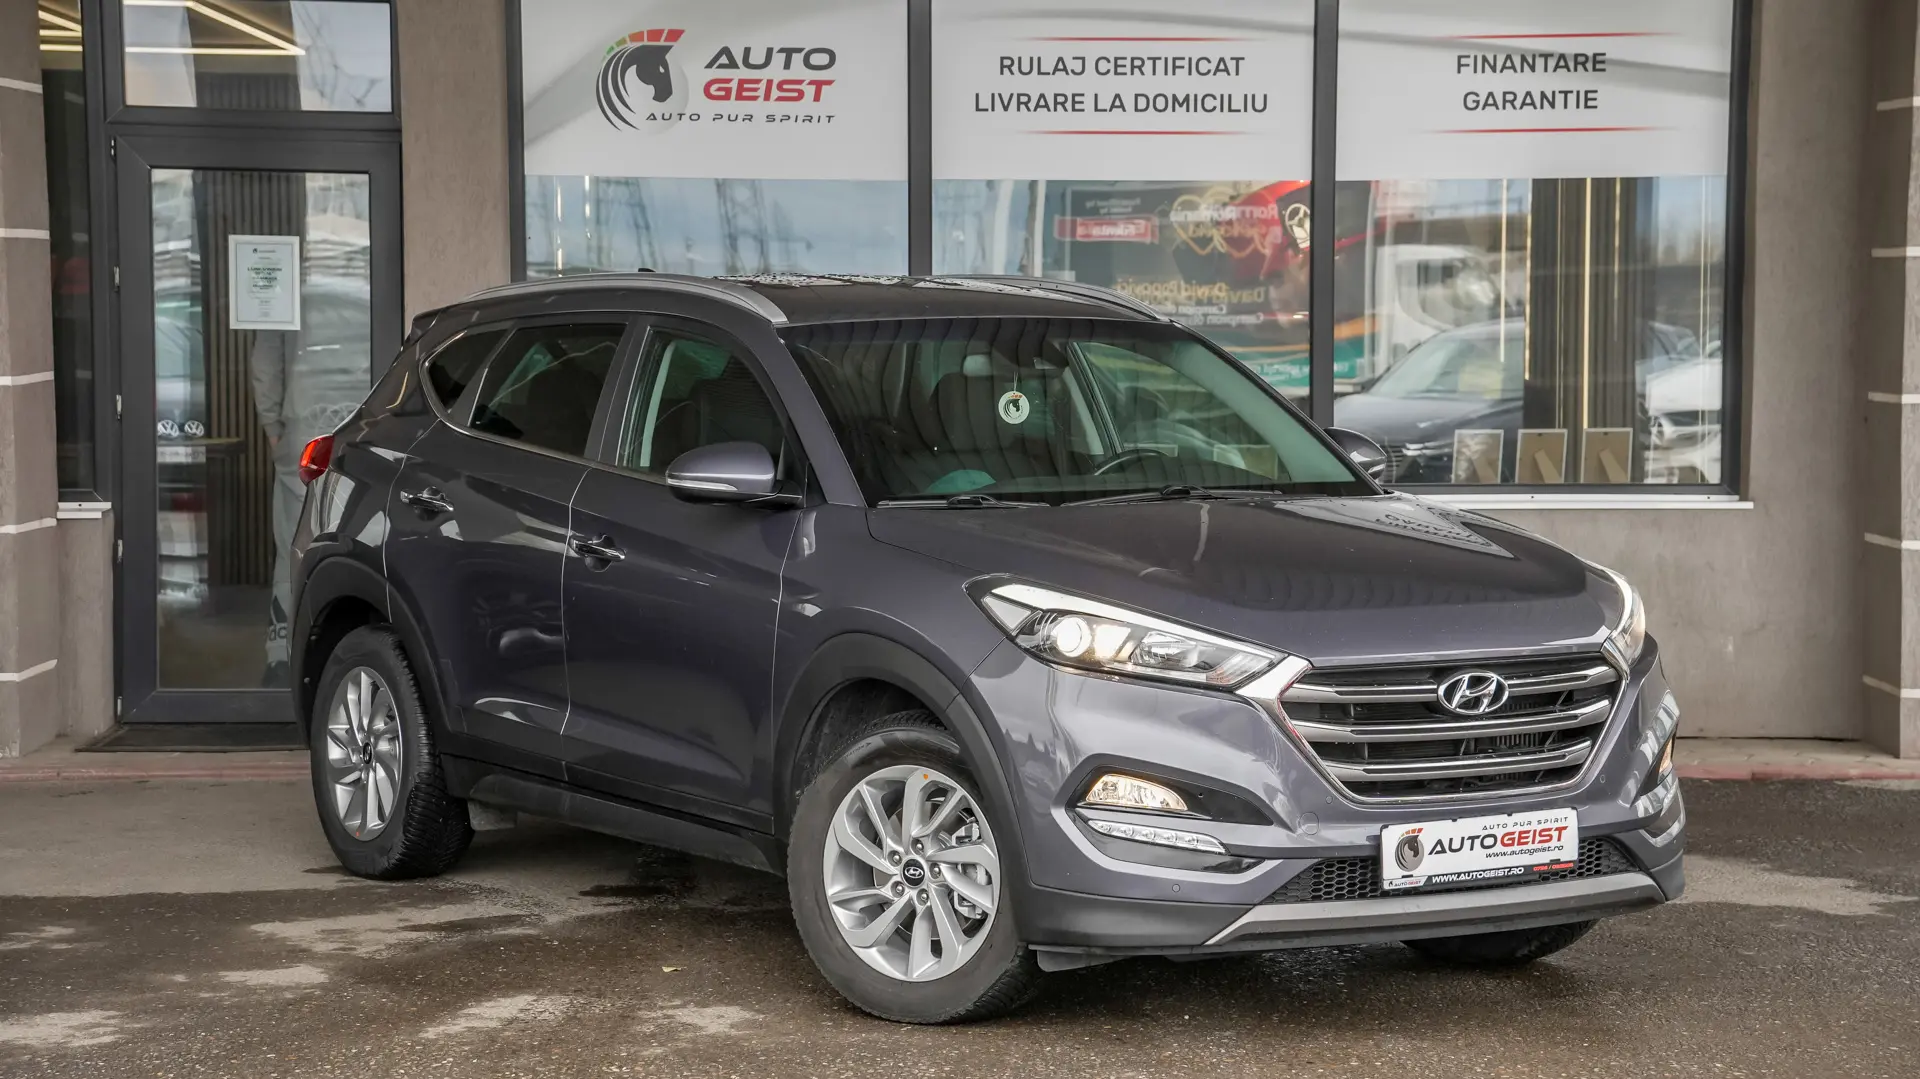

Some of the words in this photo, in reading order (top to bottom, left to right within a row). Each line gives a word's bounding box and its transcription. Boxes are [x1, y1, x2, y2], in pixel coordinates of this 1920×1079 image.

[704, 46, 836, 71] AUTO
[999, 56, 1086, 76] RULAJ
[1094, 56, 1246, 76] CERTIFICAT
[1457, 53, 1608, 74] FINANTARE
[703, 78, 836, 102] GEIST
[1463, 90, 1599, 111] GARANTIE
[975, 92, 1086, 113] LIVRARE
[1094, 93, 1127, 113] LA
[1134, 93, 1268, 113] DOMICILIU
[646, 113, 701, 122] AUTO
[713, 114, 754, 122] PUR
[765, 114, 835, 124] SPIRIT
[1482, 823, 1508, 831] AUTO
[1536, 816, 1569, 825] SPIRIT
[1428, 826, 1568, 856] AUTOGEIST
[1485, 844, 1564, 859] www.autogeist.ro
[1432, 867, 1525, 884] WWW.AUTOGEIST.RO
